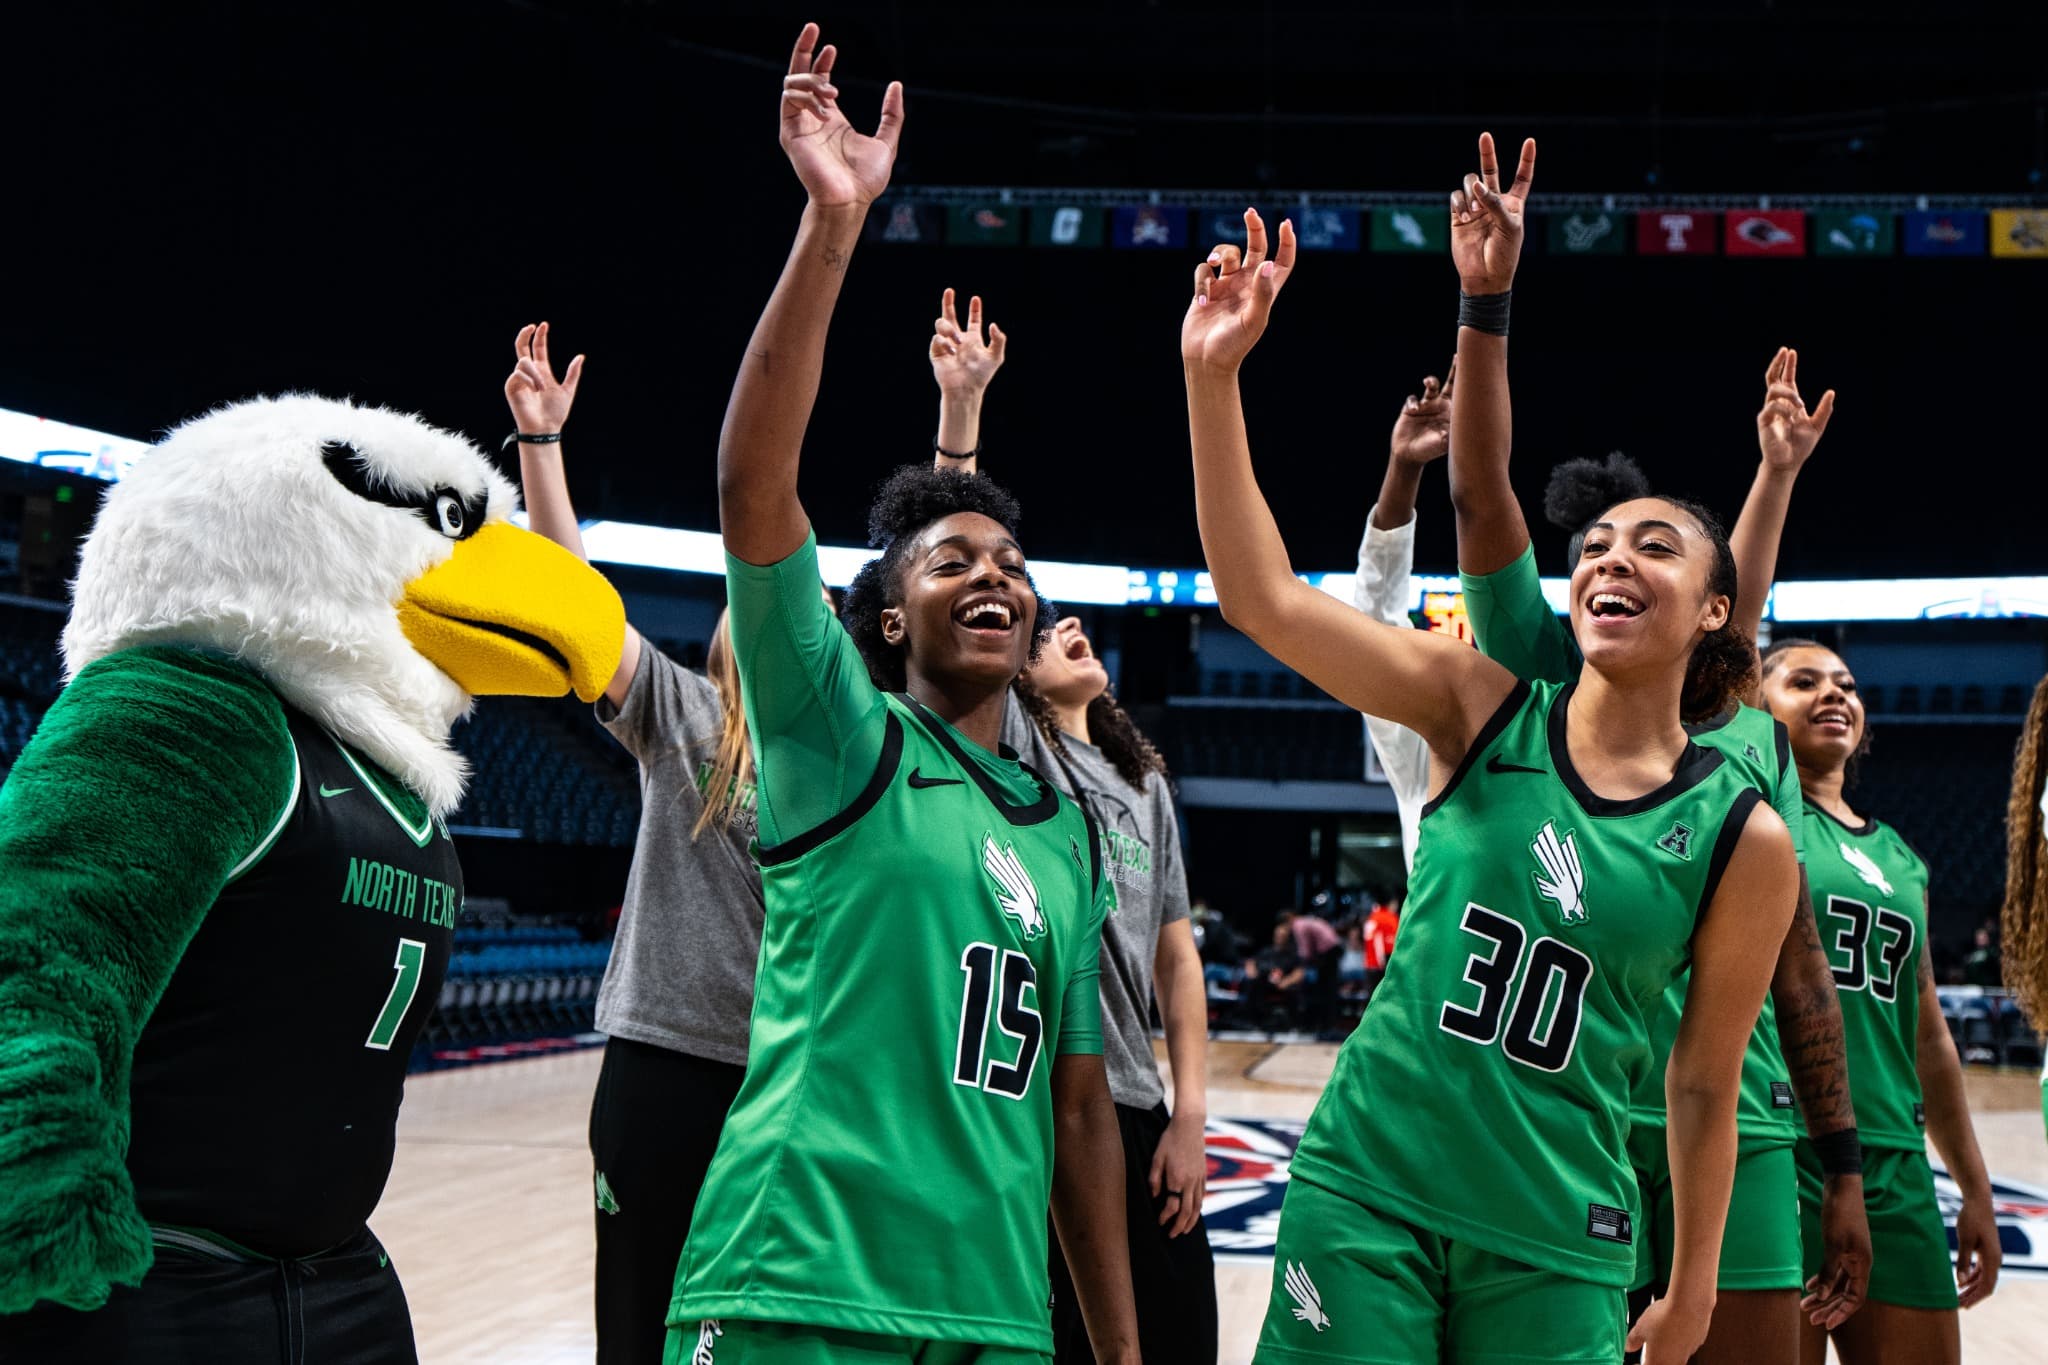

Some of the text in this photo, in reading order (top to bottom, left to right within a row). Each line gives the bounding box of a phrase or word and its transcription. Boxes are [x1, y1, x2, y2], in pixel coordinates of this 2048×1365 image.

[1660, 214, 1693, 251] T
[341, 856, 456, 930] NORTH TEXAS
[1827, 893, 1915, 1003] 33
[364, 937, 427, 1051] 1
[953, 941, 1043, 1100] 15
[1438, 901, 1594, 1073] 30
